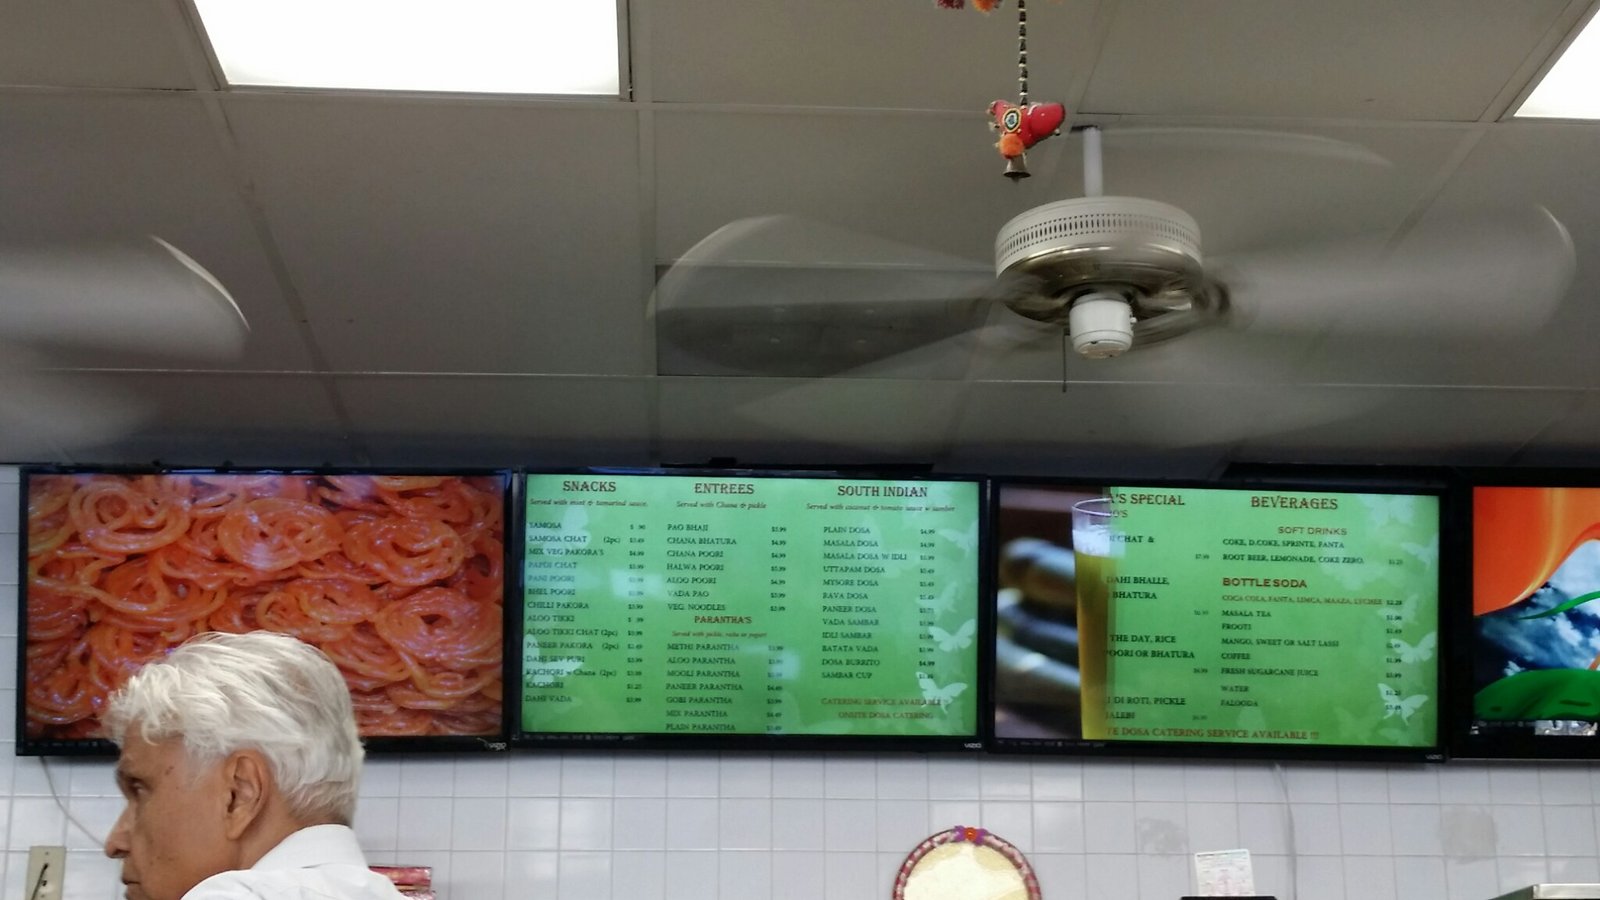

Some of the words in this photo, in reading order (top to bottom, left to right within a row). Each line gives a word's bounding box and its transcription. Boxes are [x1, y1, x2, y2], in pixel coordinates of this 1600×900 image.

[563, 480, 616, 492] SNACKS
[694, 483, 754, 494] ENTREES
[837, 485, 879, 497] SOUTH
[884, 485, 928, 497] INDIAN
[530, 498, 551, 506] Served
[1130, 493, 1185, 505] SPECIAL
[1251, 496, 1338, 510] BEVERAGES
[806, 503, 827, 511] Served
[830, 503, 843, 511] with
[823, 526, 847, 534] PLAIN
[849, 526, 871, 534] DOSA
[1278, 526, 1305, 534] SOFT
[1308, 527, 1347, 536] DRINKS
[528, 535, 562, 543] SAMOSA
[563, 535, 587, 543] CHAT
[667, 537, 697, 545] CHANA
[698, 537, 737, 545] BHATURA
[823, 539, 856, 547] MASALA
[857, 539, 879, 547] DOSA
[546, 548, 564, 556] VEG
[667, 550, 696, 558] CHANA
[698, 550, 724, 558] POORI
[823, 552, 855, 560] MASALA
[857, 552, 879, 560] DOSA
[891, 553, 907, 561] IDLI
[667, 563, 697, 571] HALWA
[699, 563, 724, 571] POORI
[823, 565, 862, 574] UTTAPAM
[864, 565, 885, 574] DOSA
[823, 578, 854, 587] MYSORE
[857, 578, 879, 587] DOSA
[1223, 578, 1271, 587] BOTTLE
[1273, 578, 1307, 588] SODA
[847, 592, 868, 600] DOSA
[1113, 592, 1158, 600] BHATURA
[688, 603, 726, 611] NOODLES
[822, 605, 853, 613] PANEER
[855, 605, 877, 613] DOSA
[1222, 610, 1254, 618] MASALA
[1257, 610, 1272, 618] TEA
[694, 615, 752, 624] PARANTHA'S
[823, 618, 845, 626] VADA
[526, 628, 551, 636] ALOO
[576, 628, 599, 636] CHAT
[1110, 634, 1128, 643] THE
[1155, 635, 1176, 643] RICE
[696, 643, 740, 651] PARANTHA
[1297, 639, 1316, 647] SALT
[822, 645, 853, 653] BATATA
[855, 645, 879, 653] VADA
[1135, 650, 1148, 658] OR
[1151, 650, 1195, 659] BHATURA
[822, 658, 843, 666] DOSA
[696, 670, 740, 678] PARANTHA
[1221, 667, 1246, 675] FRESH
[699, 683, 743, 691] PARANTHA
[864, 698, 896, 706] SERVICE
[1154, 697, 1186, 705] PICKLE
[1122, 728, 1149, 737] DOSA
[1152, 728, 1204, 737] CATERING
[1207, 729, 1248, 738] SERVICE
[1251, 730, 1308, 740] AVAILABLE
